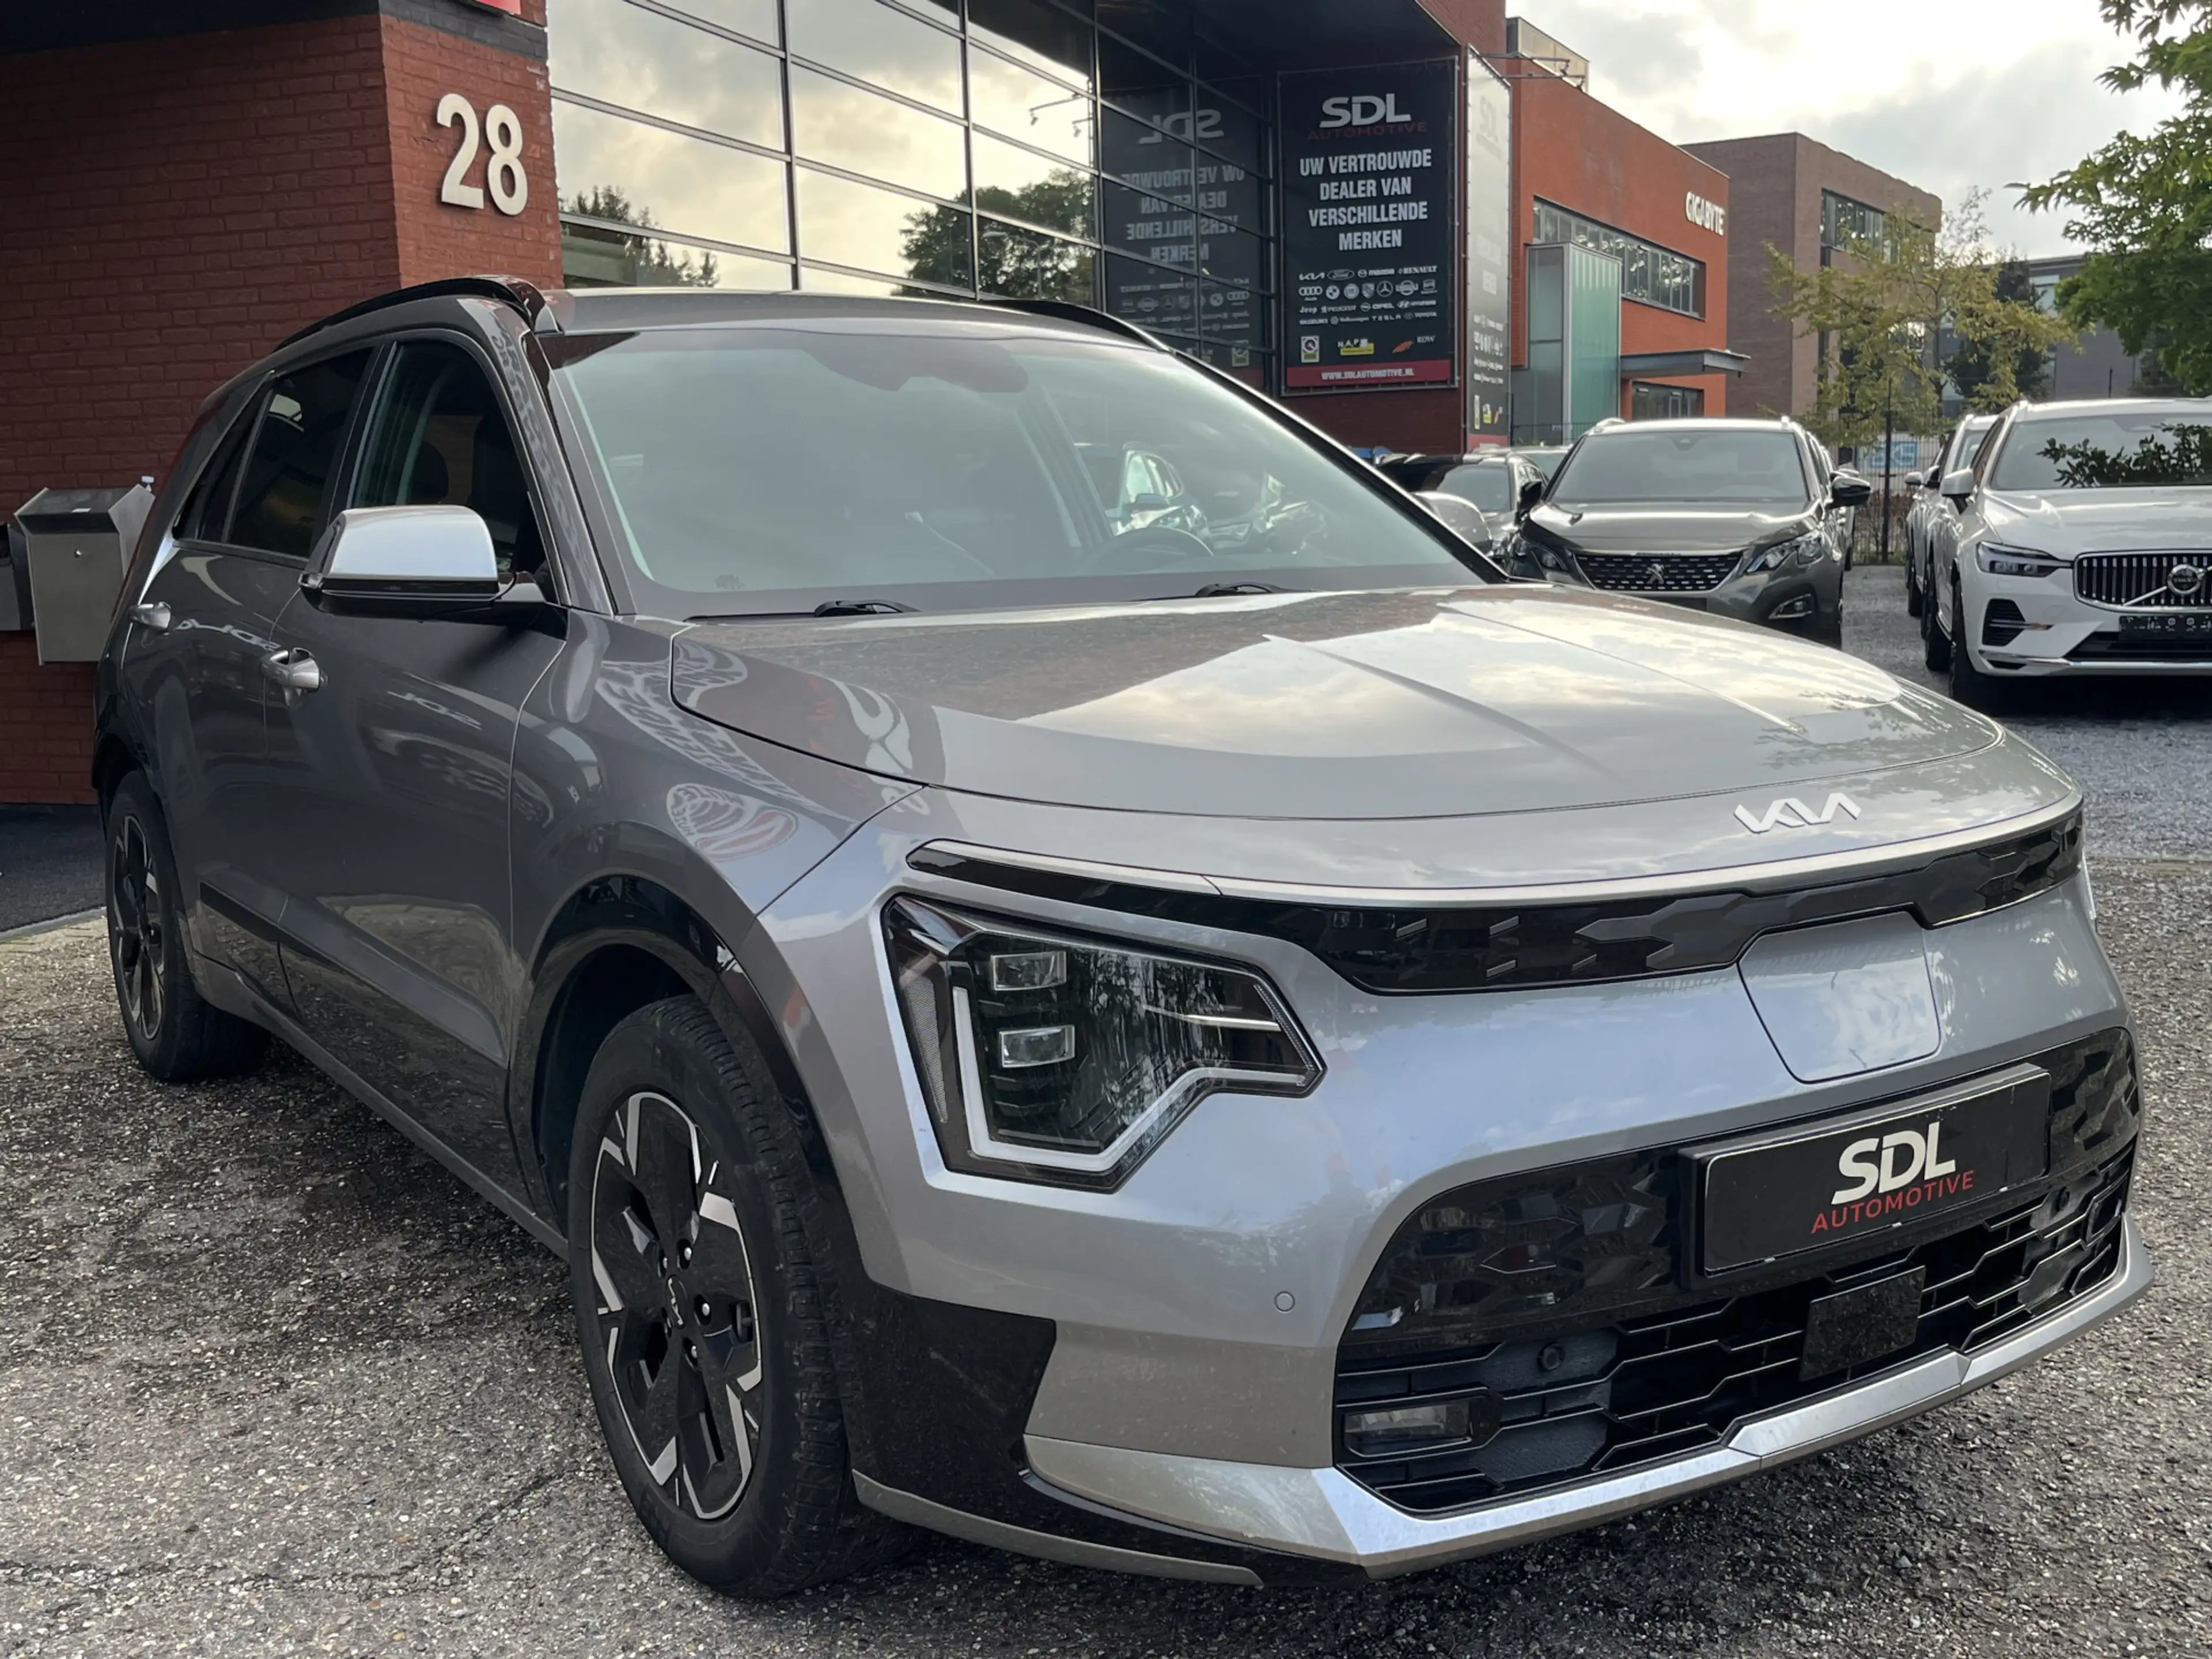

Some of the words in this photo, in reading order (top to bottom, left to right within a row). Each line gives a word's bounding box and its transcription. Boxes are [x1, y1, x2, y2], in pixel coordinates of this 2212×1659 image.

[1319, 93, 1411, 128] SDL
[1306, 122, 1428, 141] AUTOMOTIVE
[437, 93, 528, 215] 28
[1300, 157, 1324, 176] UW
[1328, 149, 1431, 173] VERTROUWDE
[1320, 179, 1377, 200] DEALER
[1381, 176, 1411, 196] VAN
[1308, 201, 1427, 227] VERSCHILLENDE
[1339, 229, 1402, 251] MERKEN
[1831, 1122, 1956, 1205] SDL
[1810, 1170, 1975, 1234] AUTOMOTIVE
